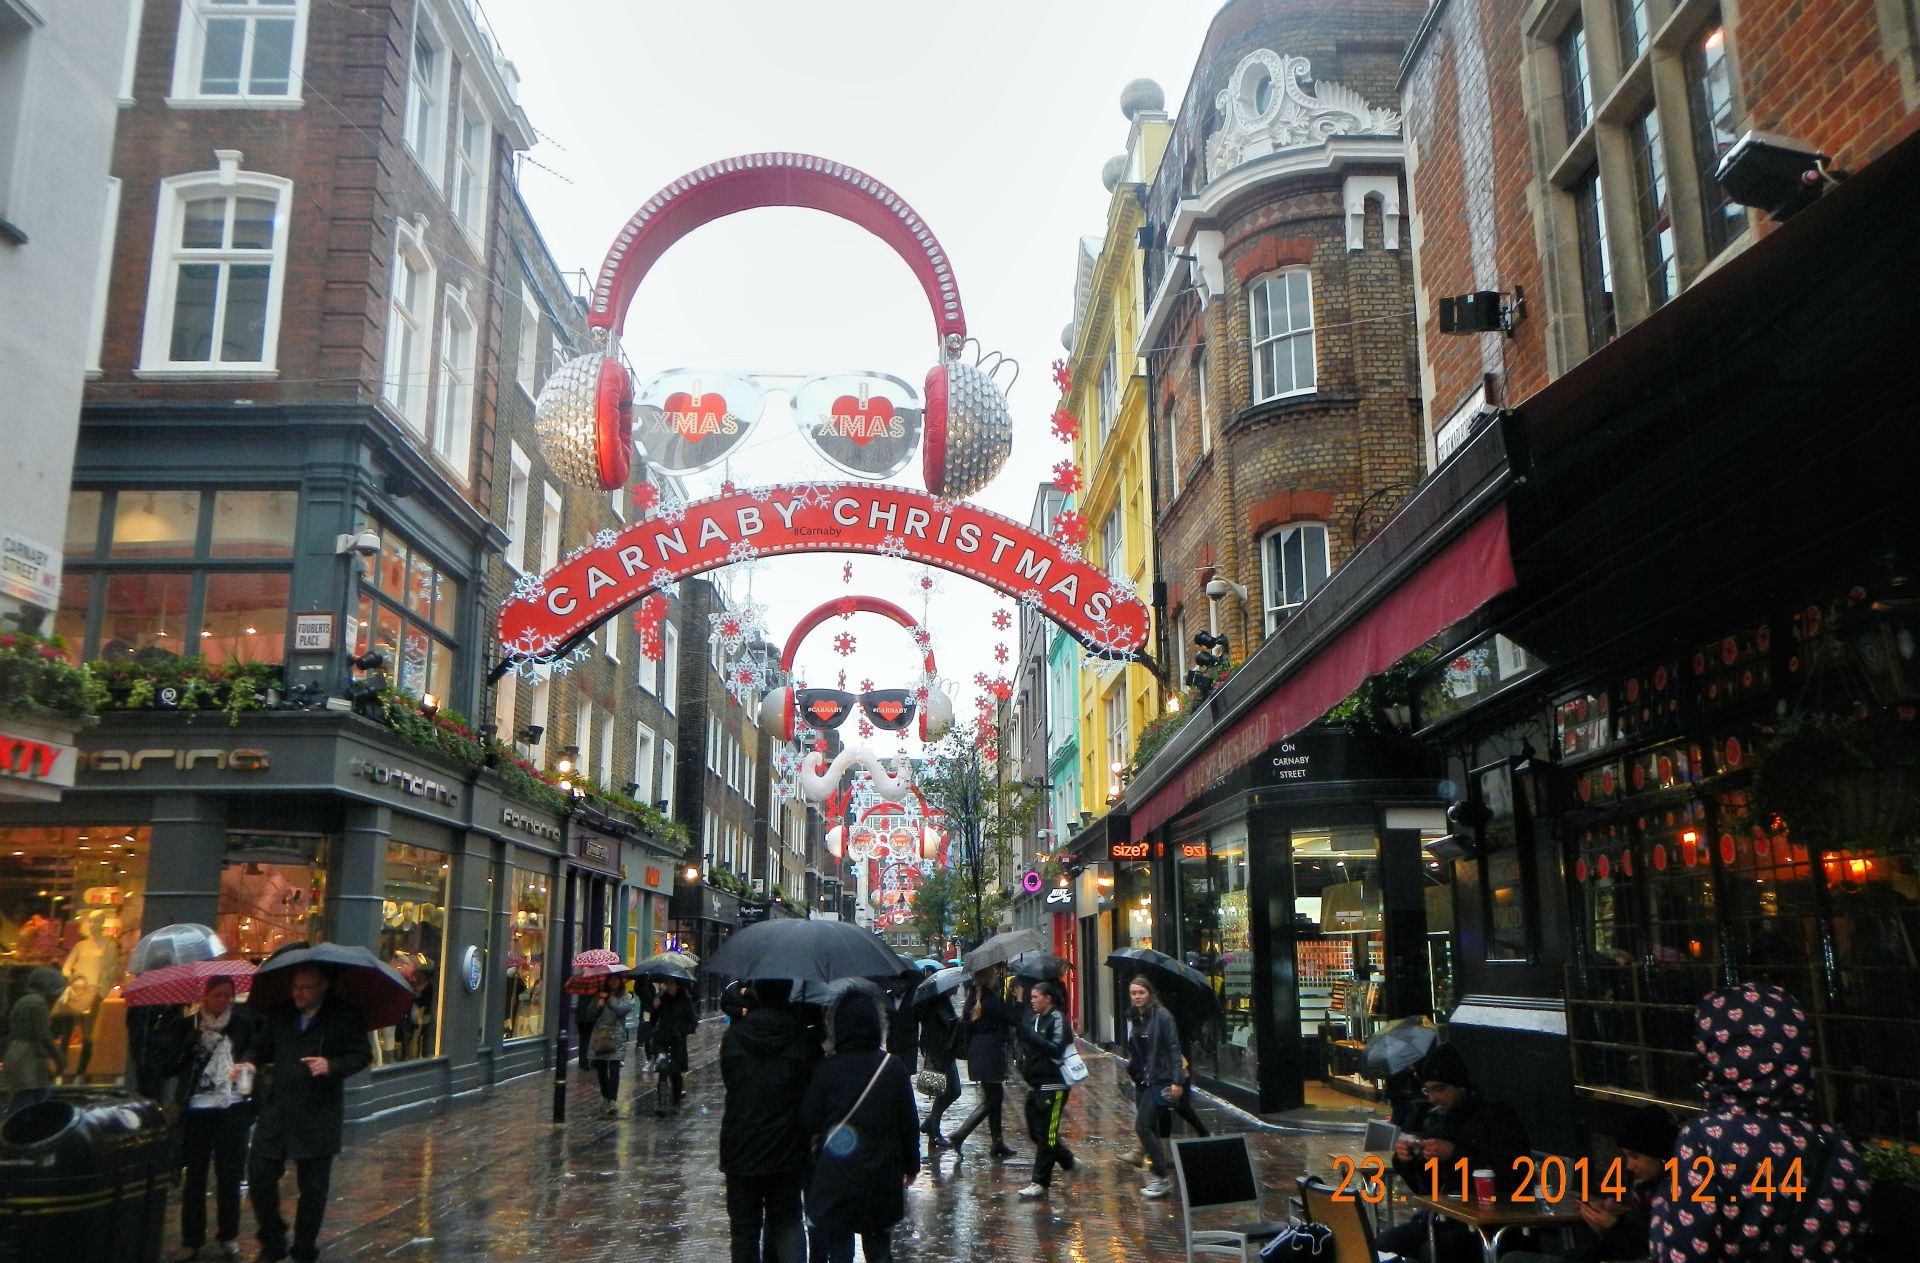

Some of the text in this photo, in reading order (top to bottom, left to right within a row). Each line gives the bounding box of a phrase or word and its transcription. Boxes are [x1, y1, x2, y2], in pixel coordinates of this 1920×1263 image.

[650, 411, 739, 434] XMAS
[818, 414, 905, 438] XMAS
[794, 526, 842, 538] #Carnaby
[4, 537, 49, 568] CARNABY
[547, 496, 1113, 622] CARNABY CHRISTMAS
[3, 555, 39, 582] STREET
[298, 623, 330, 634] FOUBERTS
[299, 635, 320, 646] PLACE
[872, 706, 908, 714] #CARNABY
[1281, 743, 1296, 752] ON
[1272, 756, 1310, 766] CARNABY
[1280, 769, 1307, 779] STREET
[1112, 842, 1150, 857] size?
[1051, 888, 1069, 897] NIKE
